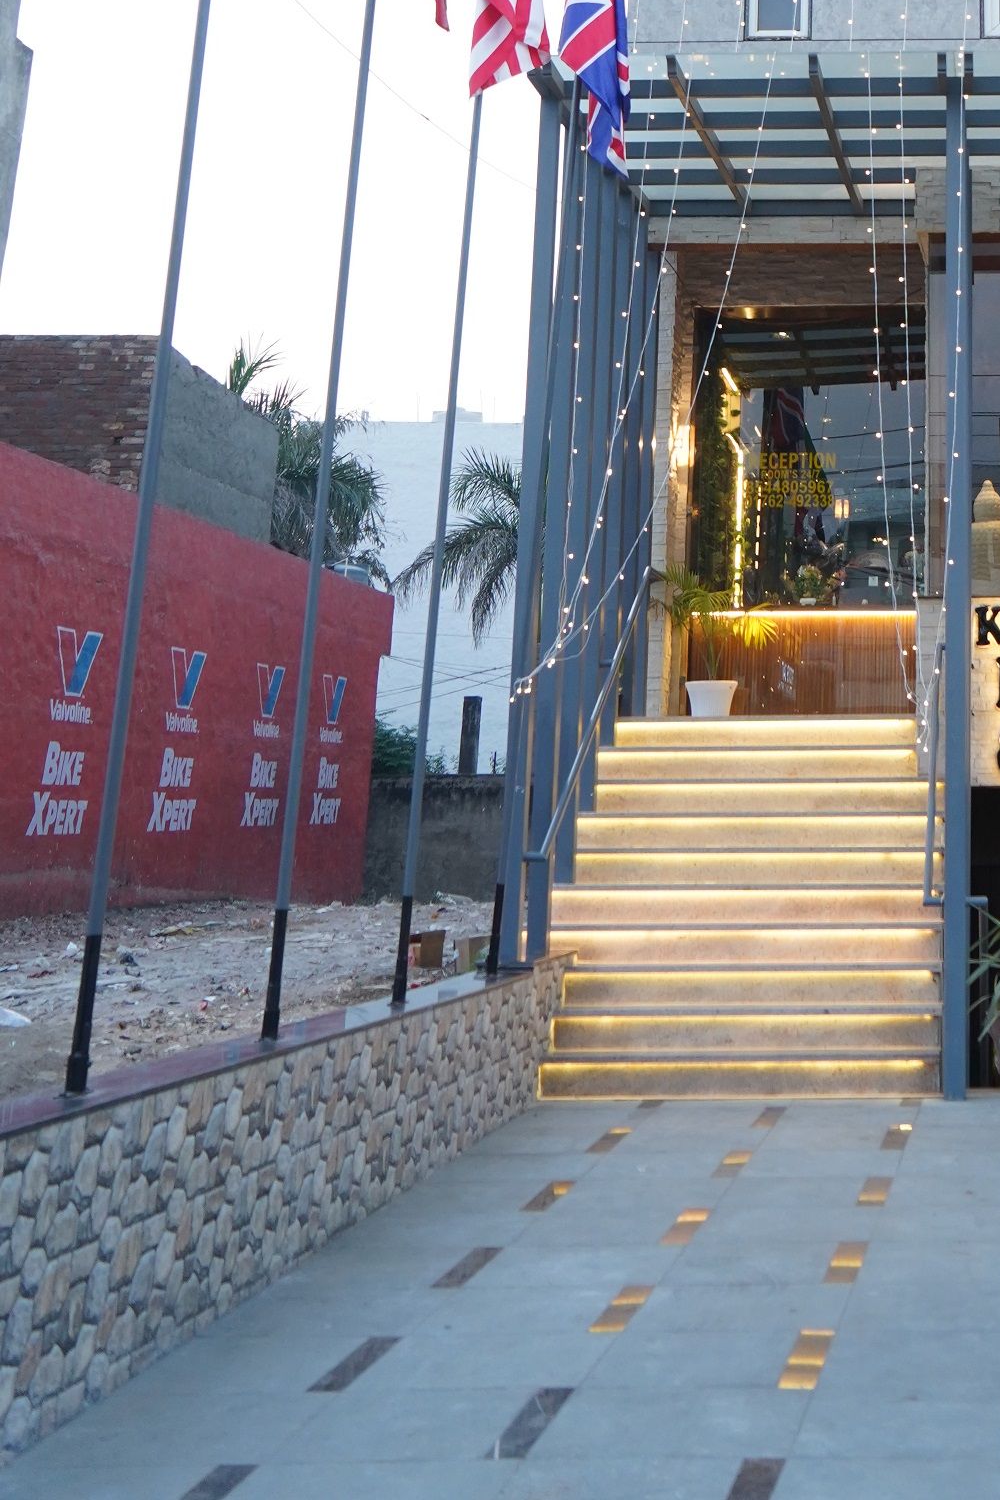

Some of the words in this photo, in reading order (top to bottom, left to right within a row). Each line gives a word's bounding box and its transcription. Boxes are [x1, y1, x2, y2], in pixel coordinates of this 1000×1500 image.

[50, 699, 91, 724] Valvoline
[166, 712, 198, 733] Valvoline
[41, 741, 85, 786] BIKE
[159, 747, 194, 788] BIKE
[26, 791, 88, 836] XPERT
[147, 791, 197, 832] XPERT
